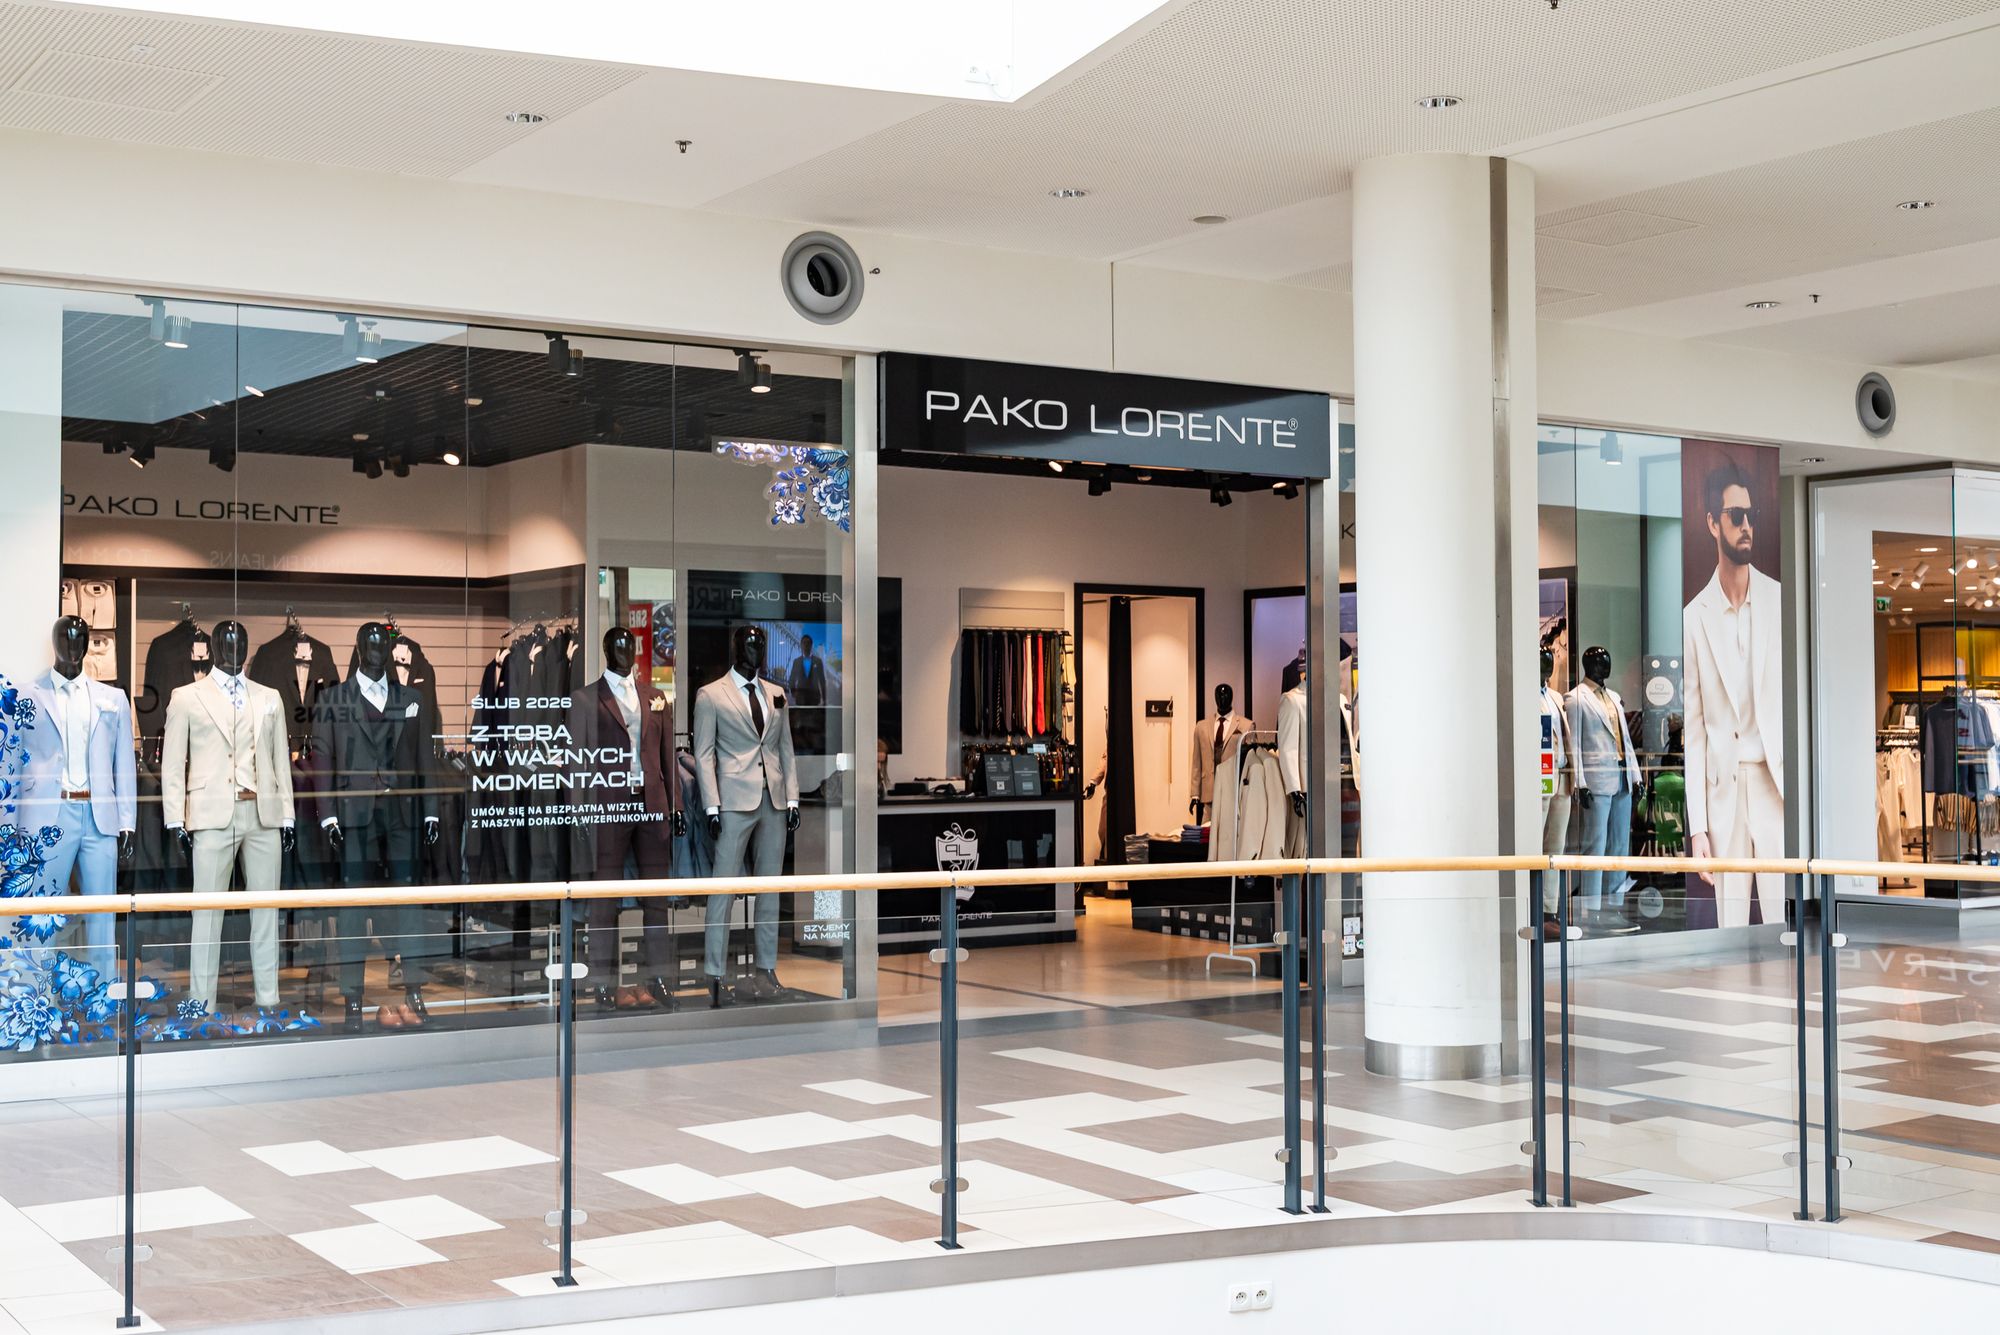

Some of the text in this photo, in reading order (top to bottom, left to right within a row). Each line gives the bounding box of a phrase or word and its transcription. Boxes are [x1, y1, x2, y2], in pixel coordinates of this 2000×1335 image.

[925, 390, 1068, 431] PAKO
[62, 493, 158, 516] PAKO
[731, 589, 780, 602] PAKO
[471, 694, 572, 709] ŚLUB 2026
[471, 724, 573, 745] Z TOBĄ
[471, 744, 637, 767] W WAŻNYCH
[472, 771, 644, 792] MOMENTACH
[471, 802, 644, 818] UMÓW SIĘ NA BEZPŁATNĄ WIZYTĘ
[471, 813, 664, 828] Z NASZYM DORADCĄ WIZERUNKOWYM
[956, 911, 993, 921] ORENTE
[803, 923, 850, 933] SZYJEMY
[803, 931, 850, 941] NA MIARĘ
